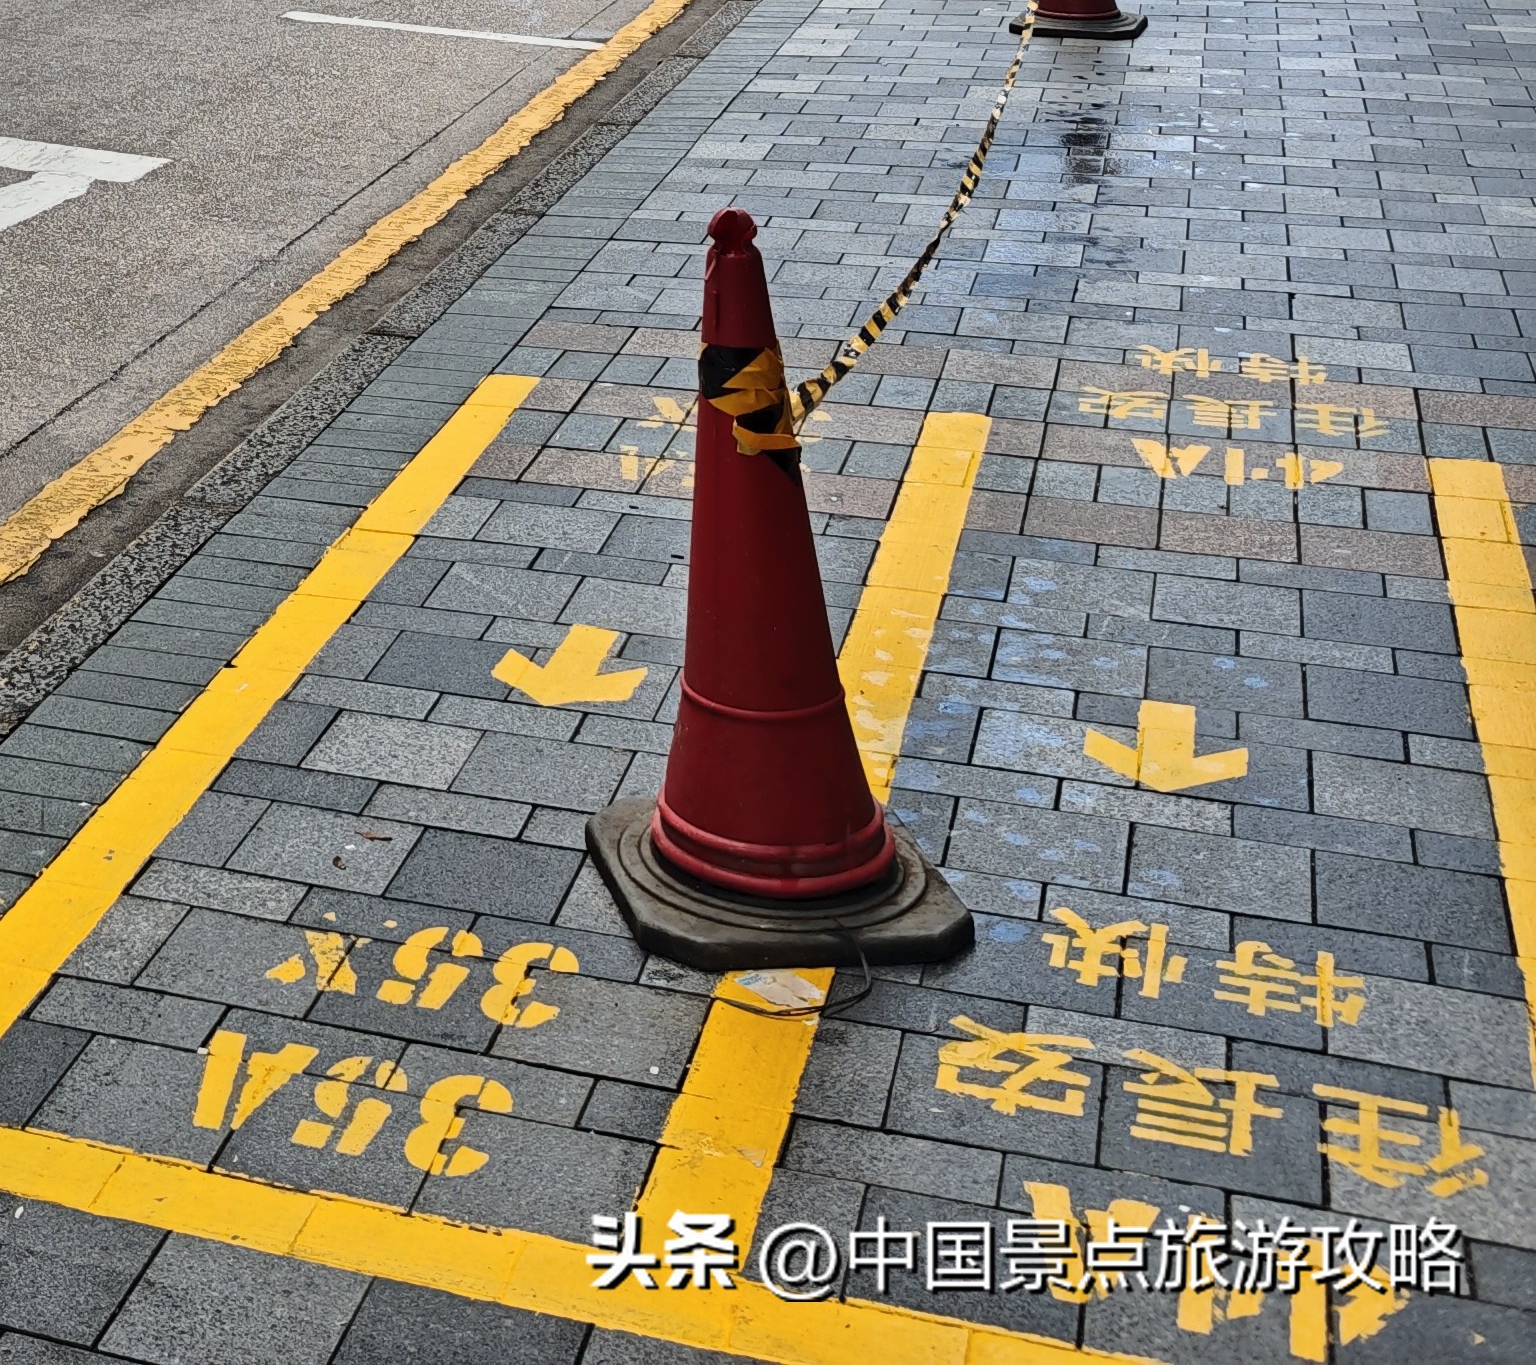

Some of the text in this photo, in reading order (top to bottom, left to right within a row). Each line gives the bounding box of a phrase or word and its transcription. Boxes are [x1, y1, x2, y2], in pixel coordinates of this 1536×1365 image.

[1078, 384, 1389, 439] 往長安
[1137, 342, 1327, 384] 特快
[1133, 437, 1345, 489] 41A
[265, 912, 580, 1028] 35X
[1041, 906, 1366, 1028] 特快
[193, 1030, 514, 1177] 35A
[935, 1015, 1491, 1198] 往長安
